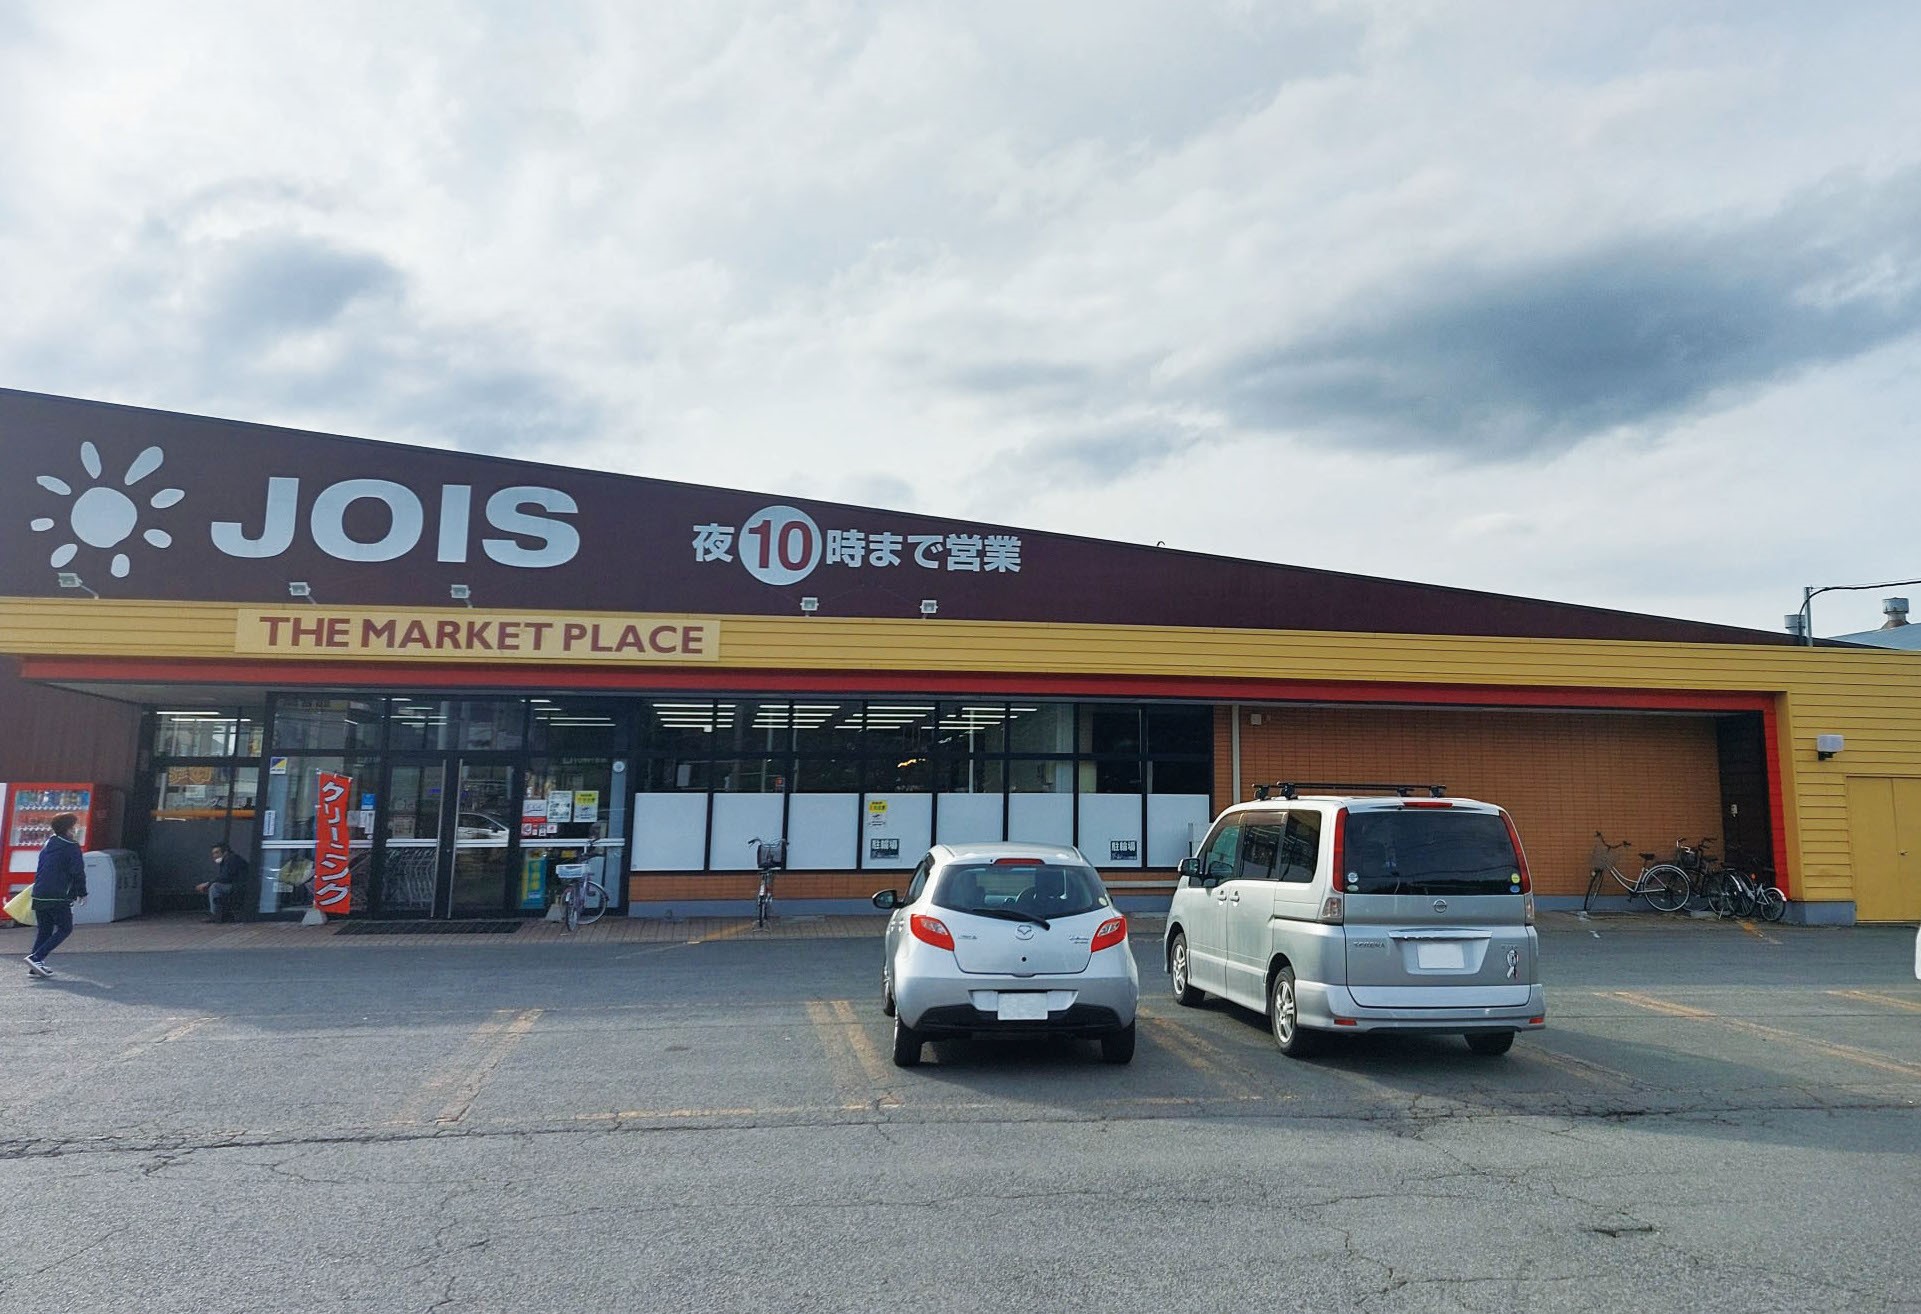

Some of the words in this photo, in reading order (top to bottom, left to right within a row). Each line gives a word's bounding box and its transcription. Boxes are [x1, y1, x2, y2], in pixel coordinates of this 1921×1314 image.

[211, 477, 580, 568] JOIS
[692, 514, 1022, 574] 夜10時まで営業
[259, 616, 349, 648] THE
[360, 619, 553, 652] MARKET
[563, 622, 704, 654] PLACE
